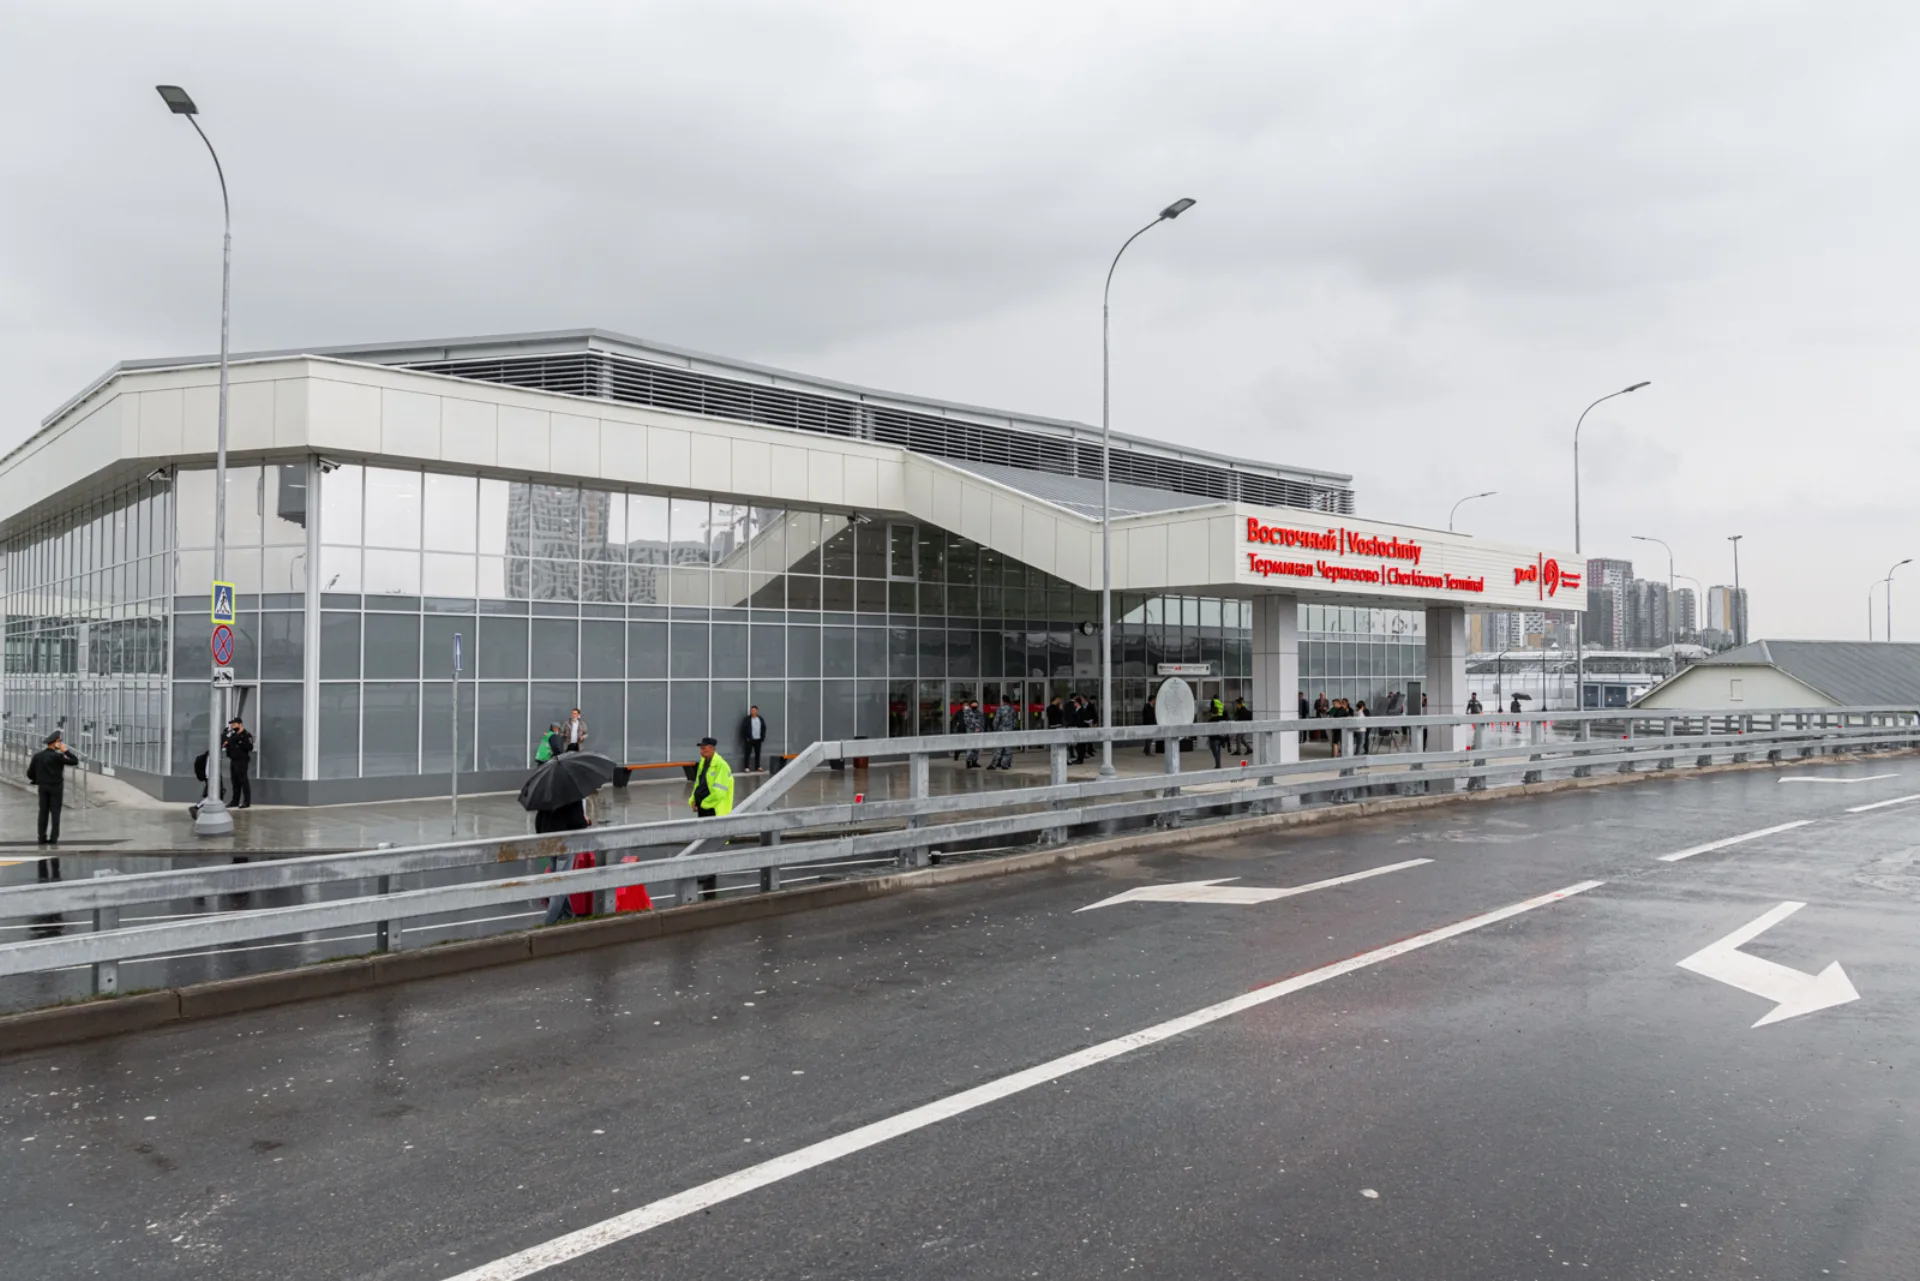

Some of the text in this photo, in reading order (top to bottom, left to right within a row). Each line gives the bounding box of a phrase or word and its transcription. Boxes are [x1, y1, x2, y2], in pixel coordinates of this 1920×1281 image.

[1248, 517, 1337, 551] Восточный
[1347, 531, 1421, 565] Vostochniy
[1248, 552, 1380, 583] Терминал Черкизово
[1387, 567, 1484, 592] Cherkizovo Terminal
